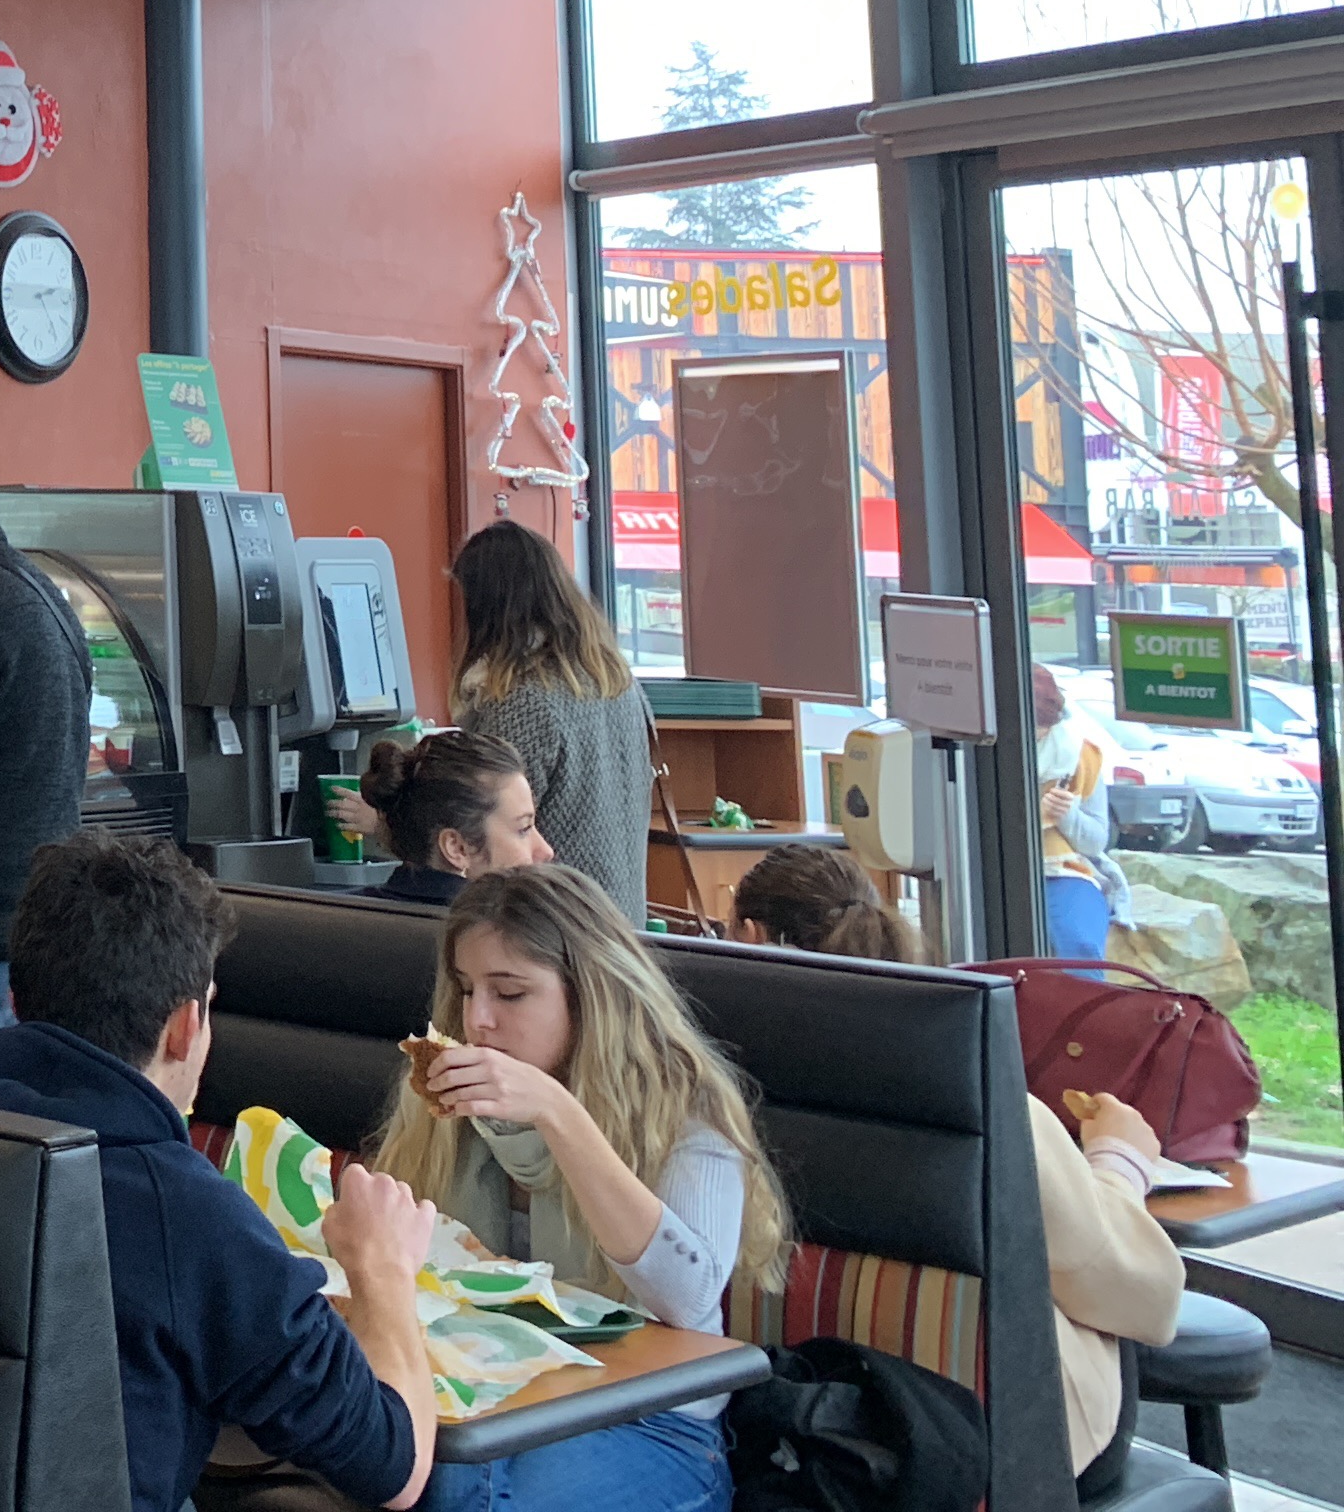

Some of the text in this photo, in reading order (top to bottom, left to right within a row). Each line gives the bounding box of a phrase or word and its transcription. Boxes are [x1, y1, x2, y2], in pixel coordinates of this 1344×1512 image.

[1134, 634, 1221, 659] SORTIE
[1144, 683, 1216, 699] A BIENTOT
